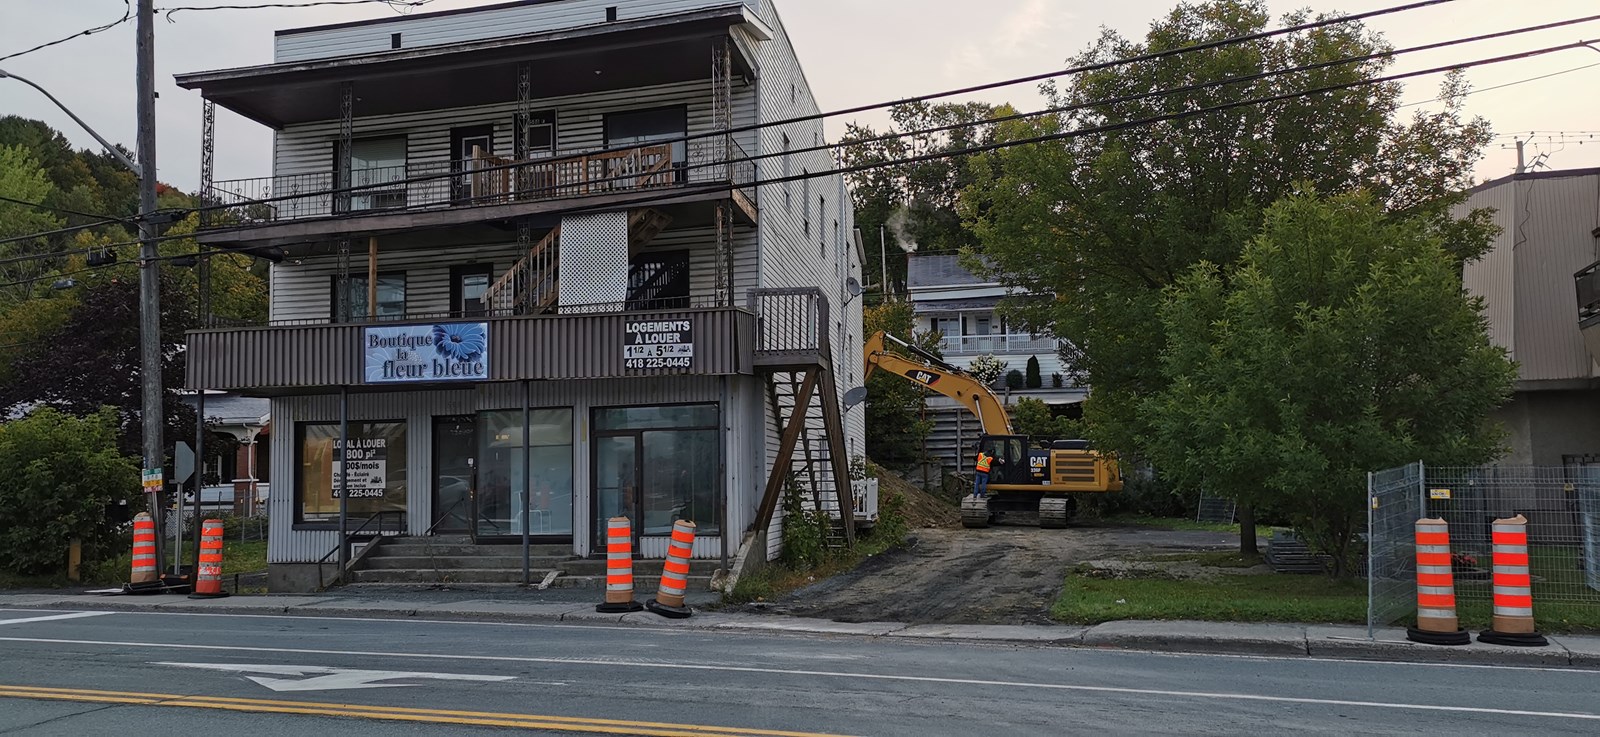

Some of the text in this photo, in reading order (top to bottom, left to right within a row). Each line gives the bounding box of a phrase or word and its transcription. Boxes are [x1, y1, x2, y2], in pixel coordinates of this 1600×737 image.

[626, 321, 690, 333] LOGEMENTS
[368, 333, 433, 351] Boutique
[635, 332, 681, 344] À LOUER
[396, 349, 408, 361] la
[382, 358, 484, 379] fleur bleue
[626, 357, 690, 368] 418 225-0445
[916, 371, 931, 384] CAT
[333, 437, 386, 449] LOAL À LOUER
[1030, 456, 1047, 467] CAT
[349, 489, 383, 497] 225-0445
